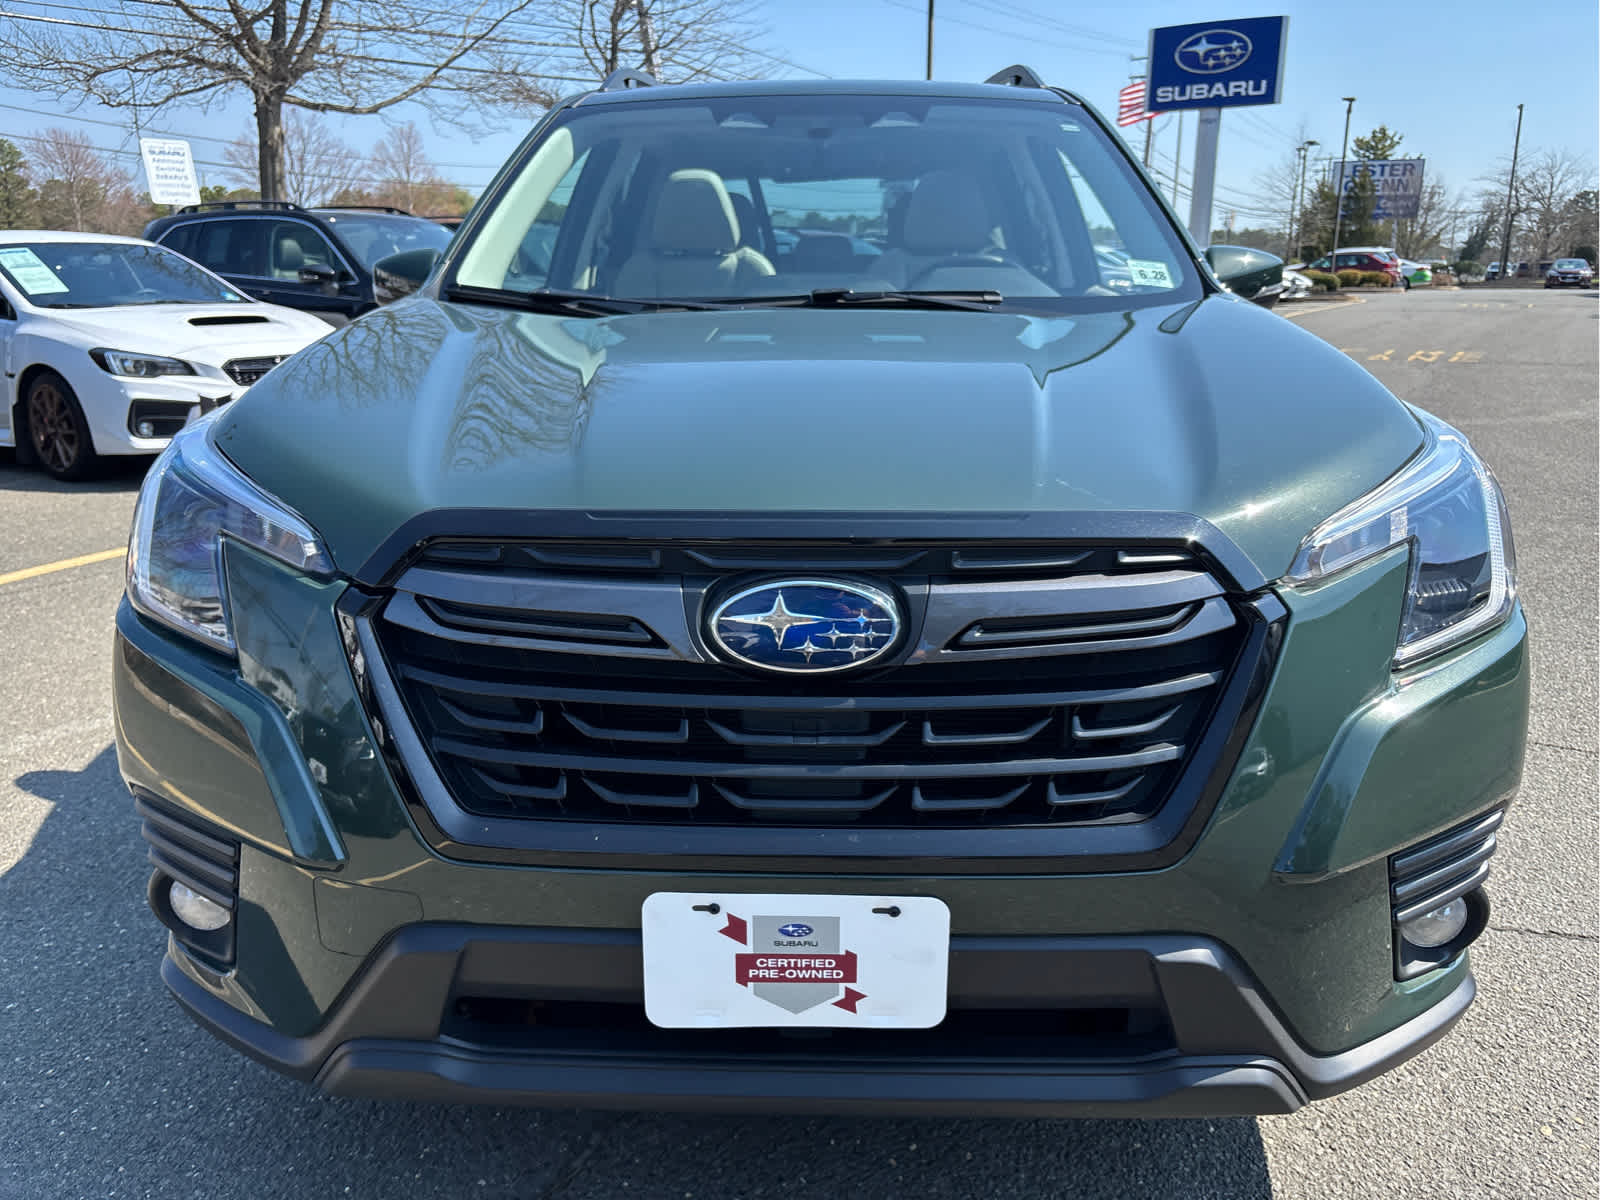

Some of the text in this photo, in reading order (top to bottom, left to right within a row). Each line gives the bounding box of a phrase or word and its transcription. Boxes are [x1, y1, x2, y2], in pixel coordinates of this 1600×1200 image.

[1156, 80, 1267, 103] SUBARU
[773, 940, 819, 948] SUBARU
[756, 958, 836, 968] CERTIFIED
[748, 969, 844, 979] PRE-OWNED
